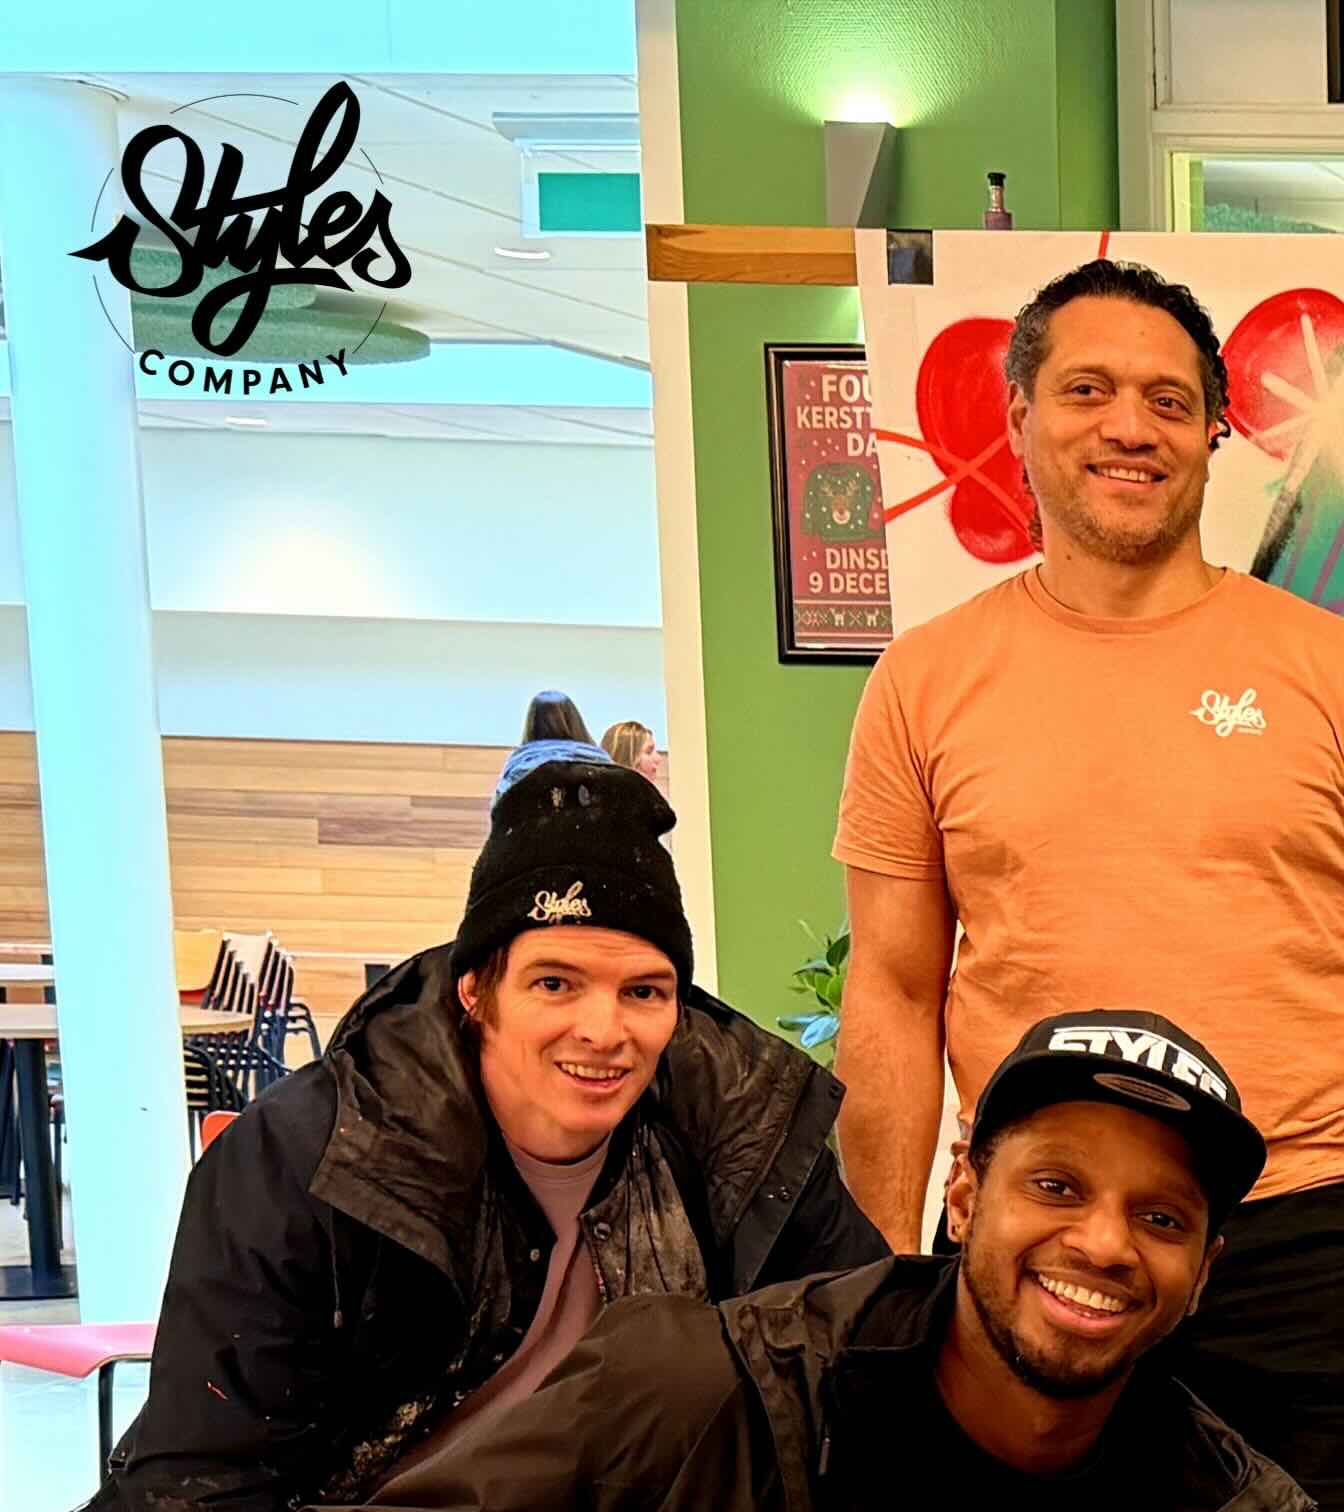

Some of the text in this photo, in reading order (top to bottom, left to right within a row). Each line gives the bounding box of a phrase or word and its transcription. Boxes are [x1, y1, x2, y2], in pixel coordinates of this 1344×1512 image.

[808, 571, 888, 595] 9 DECE
[1188, 687, 1268, 738] Styles
[526, 880, 593, 925] Styles
